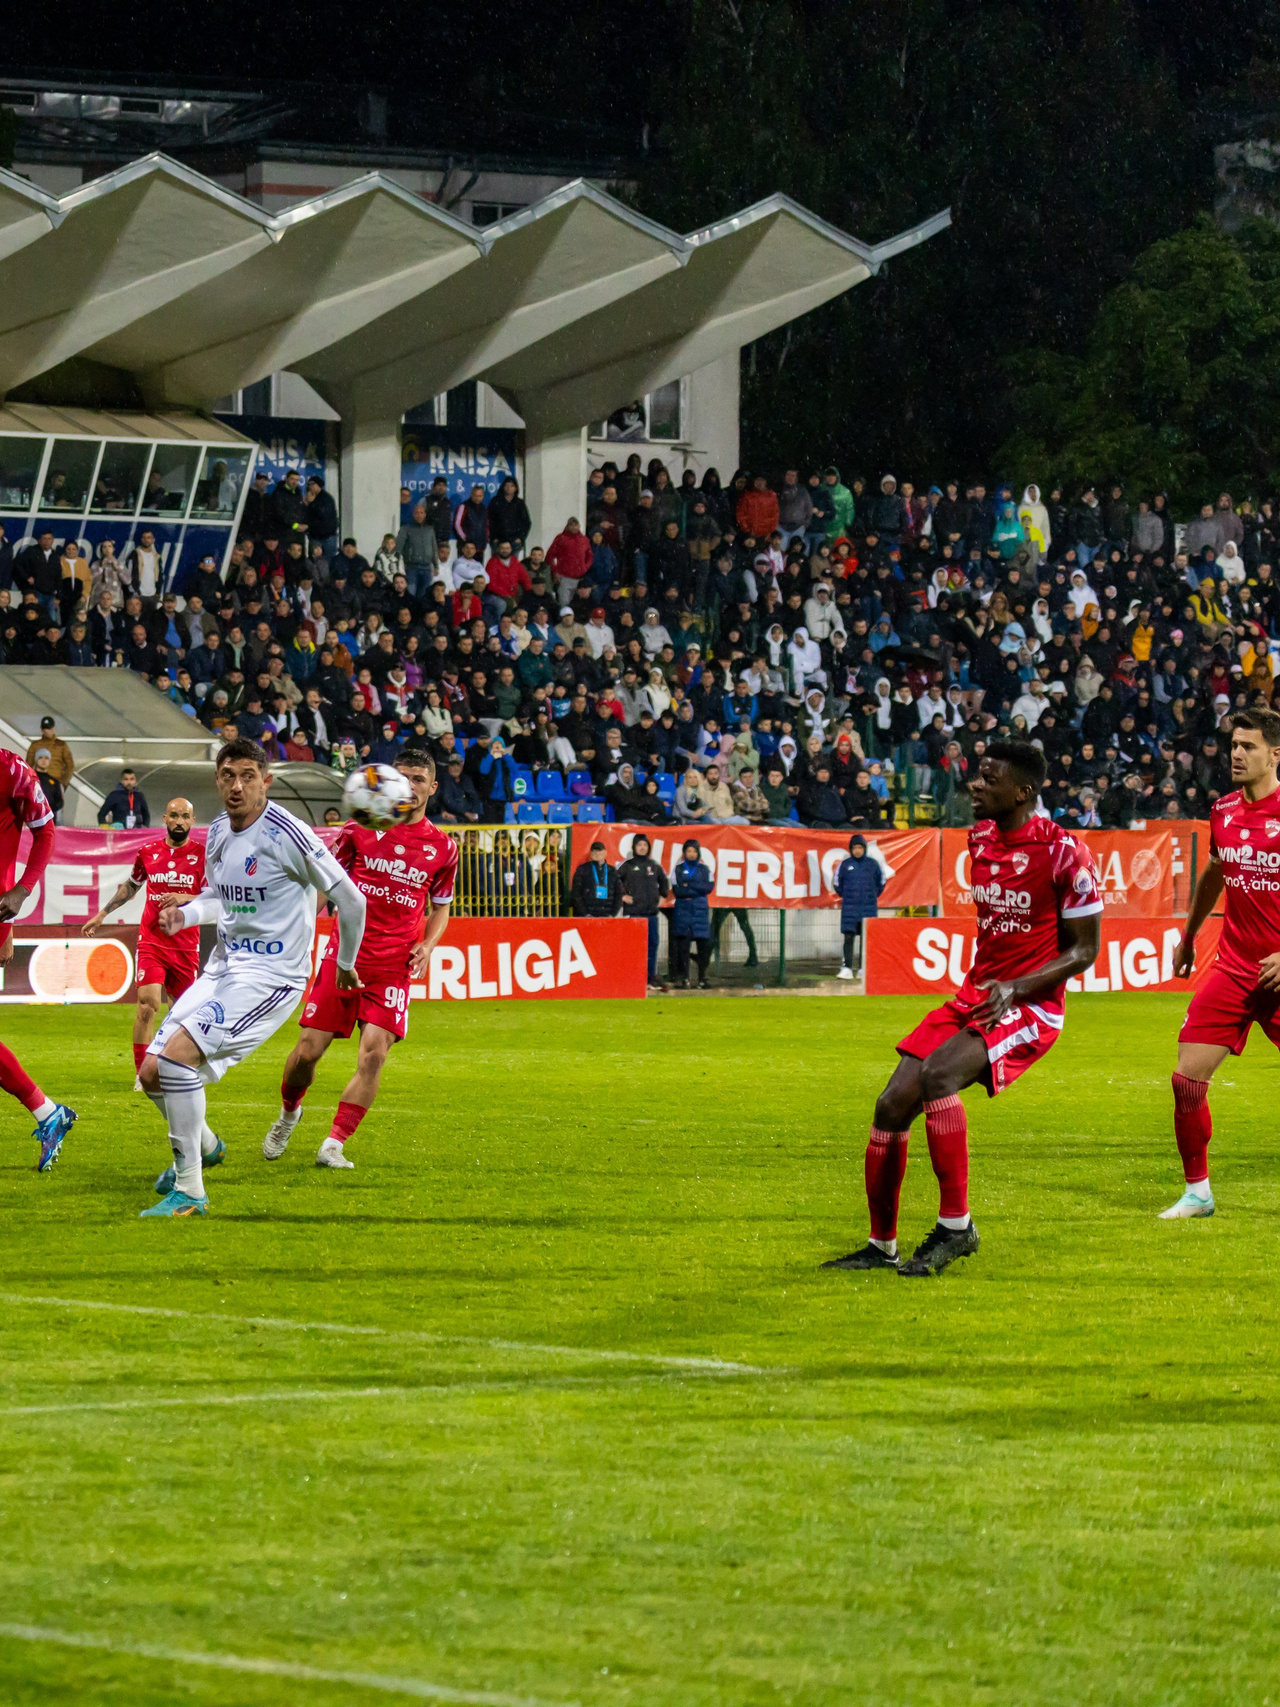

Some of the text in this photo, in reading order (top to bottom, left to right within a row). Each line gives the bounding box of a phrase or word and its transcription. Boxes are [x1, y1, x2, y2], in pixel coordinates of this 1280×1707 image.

[148, 870, 195, 885] WIN2.RO
[363, 854, 428, 884] WIN2.RO
[1011, 907, 1031, 916] SPORT
[384, 985, 406, 1013] 98
